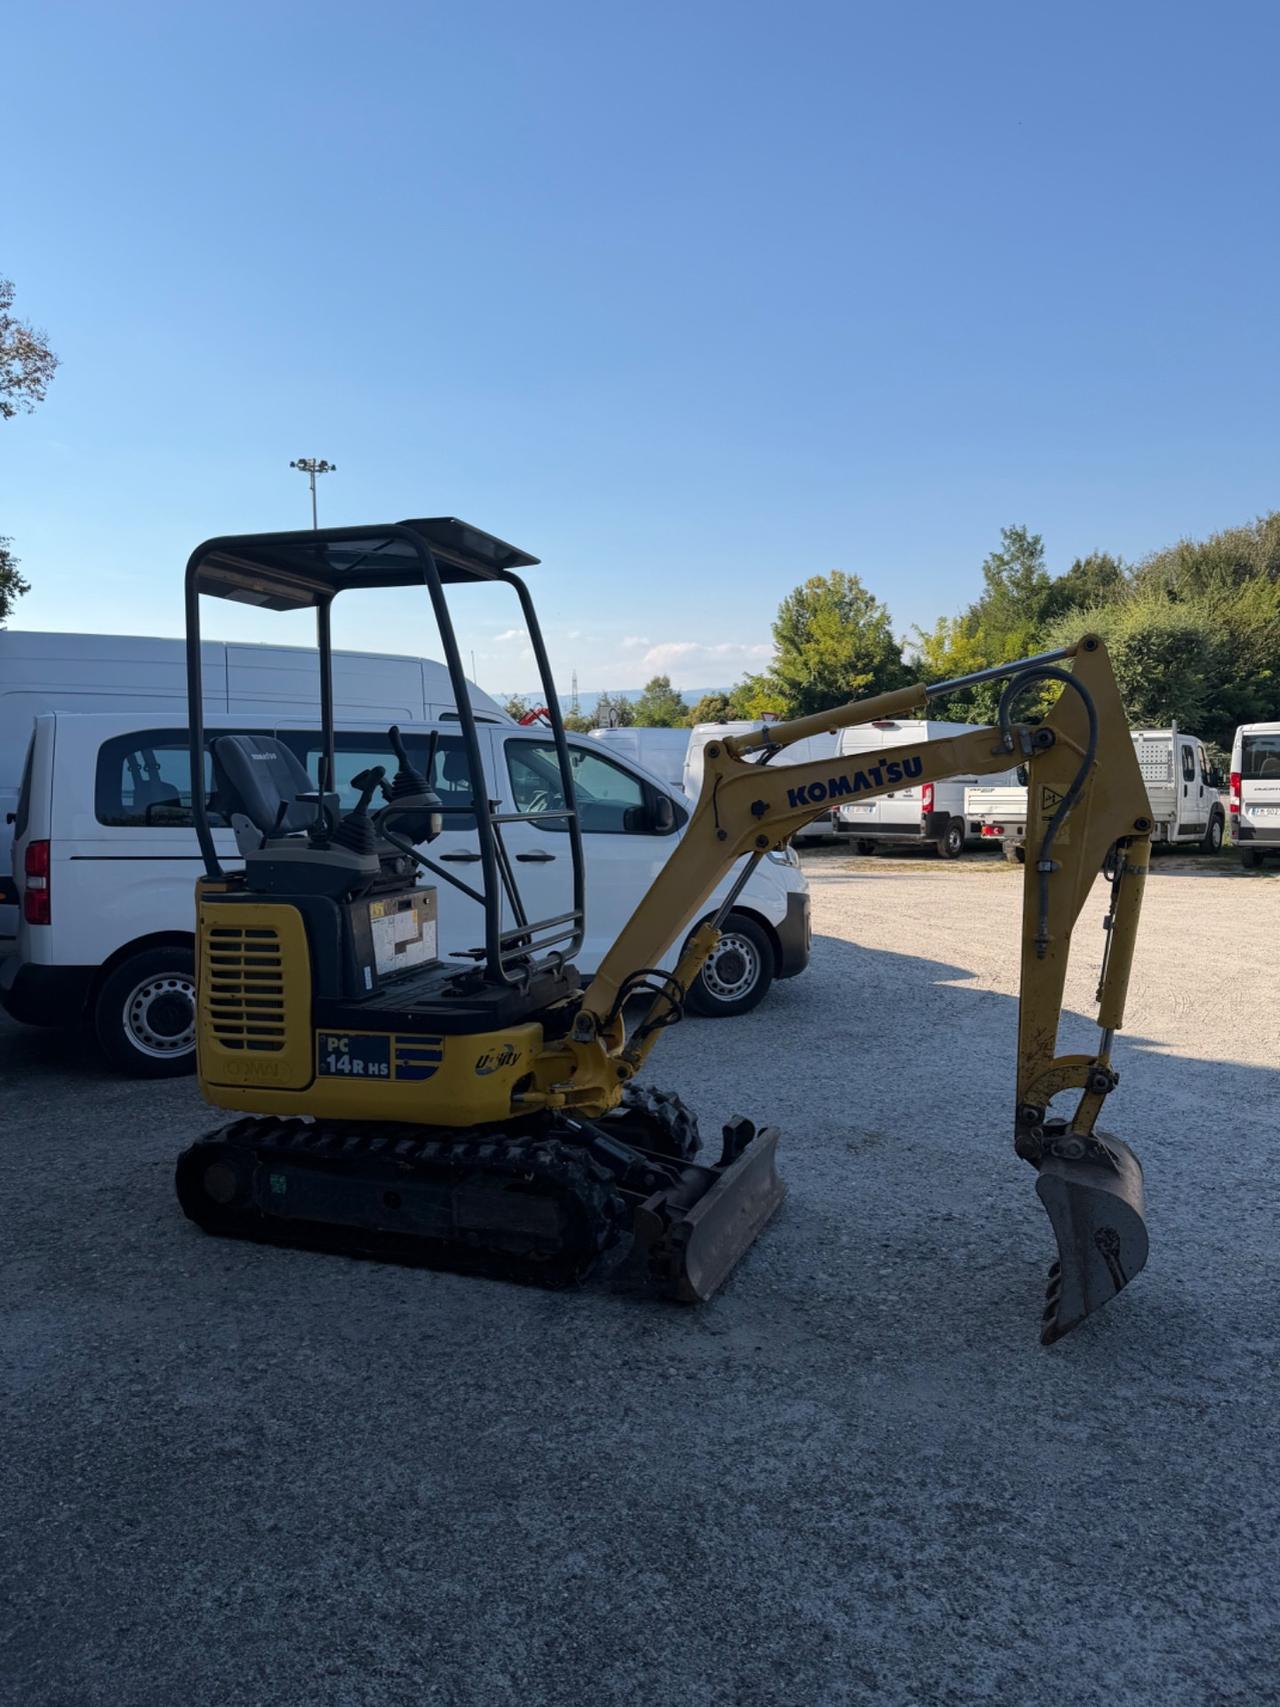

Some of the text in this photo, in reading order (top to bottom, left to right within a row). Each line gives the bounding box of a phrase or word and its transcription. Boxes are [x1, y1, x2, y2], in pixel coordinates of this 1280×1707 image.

[787, 757, 923, 807] KOMATSU
[328, 1038, 349, 1052] PC
[368, 1062, 389, 1075] HS
